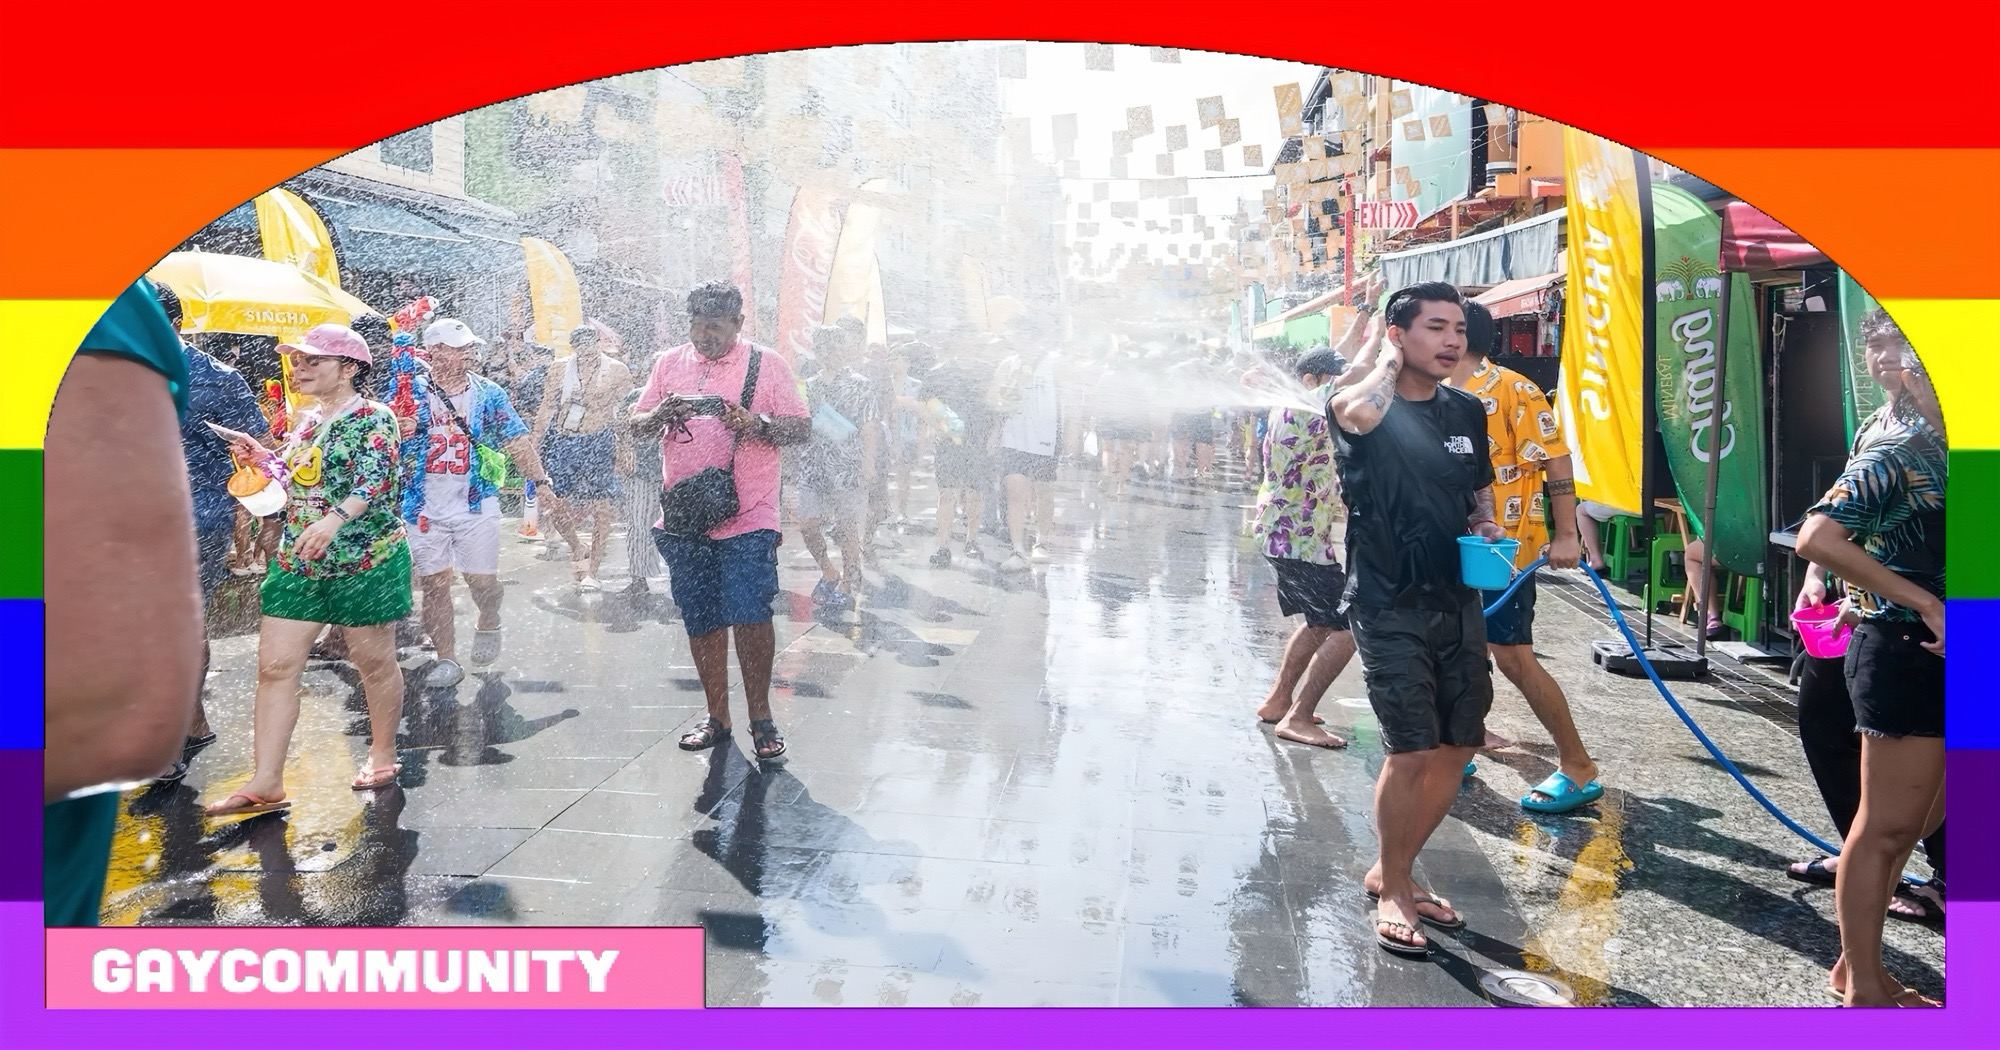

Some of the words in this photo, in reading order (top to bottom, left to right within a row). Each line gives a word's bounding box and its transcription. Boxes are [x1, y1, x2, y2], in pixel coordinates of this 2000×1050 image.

[1361, 203, 1392, 228] EXIT
[244, 309, 309, 324] SINGHA
[425, 434, 470, 474] 23
